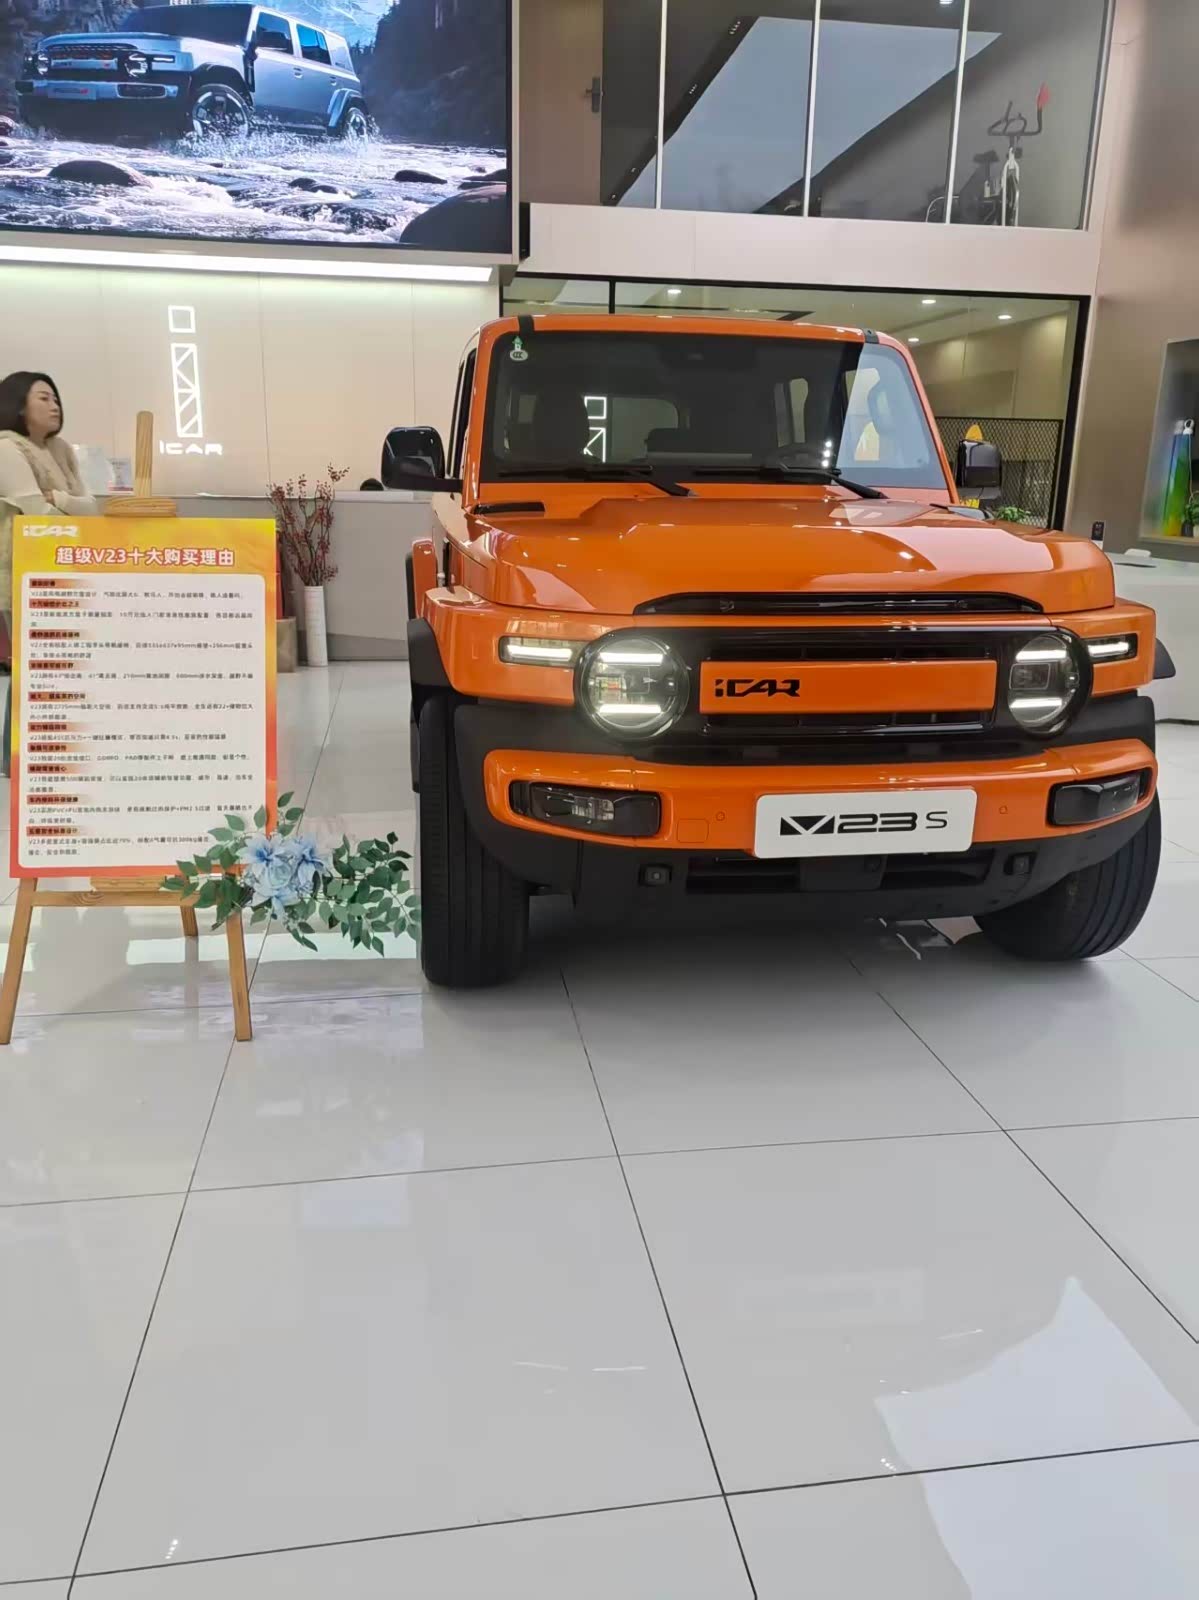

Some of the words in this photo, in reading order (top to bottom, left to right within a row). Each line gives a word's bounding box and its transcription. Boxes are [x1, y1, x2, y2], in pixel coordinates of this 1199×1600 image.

[55, 547, 235, 567] 超级V23十大购买理由
[779, 811, 919, 836] V23
[925, 810, 949, 830] S
